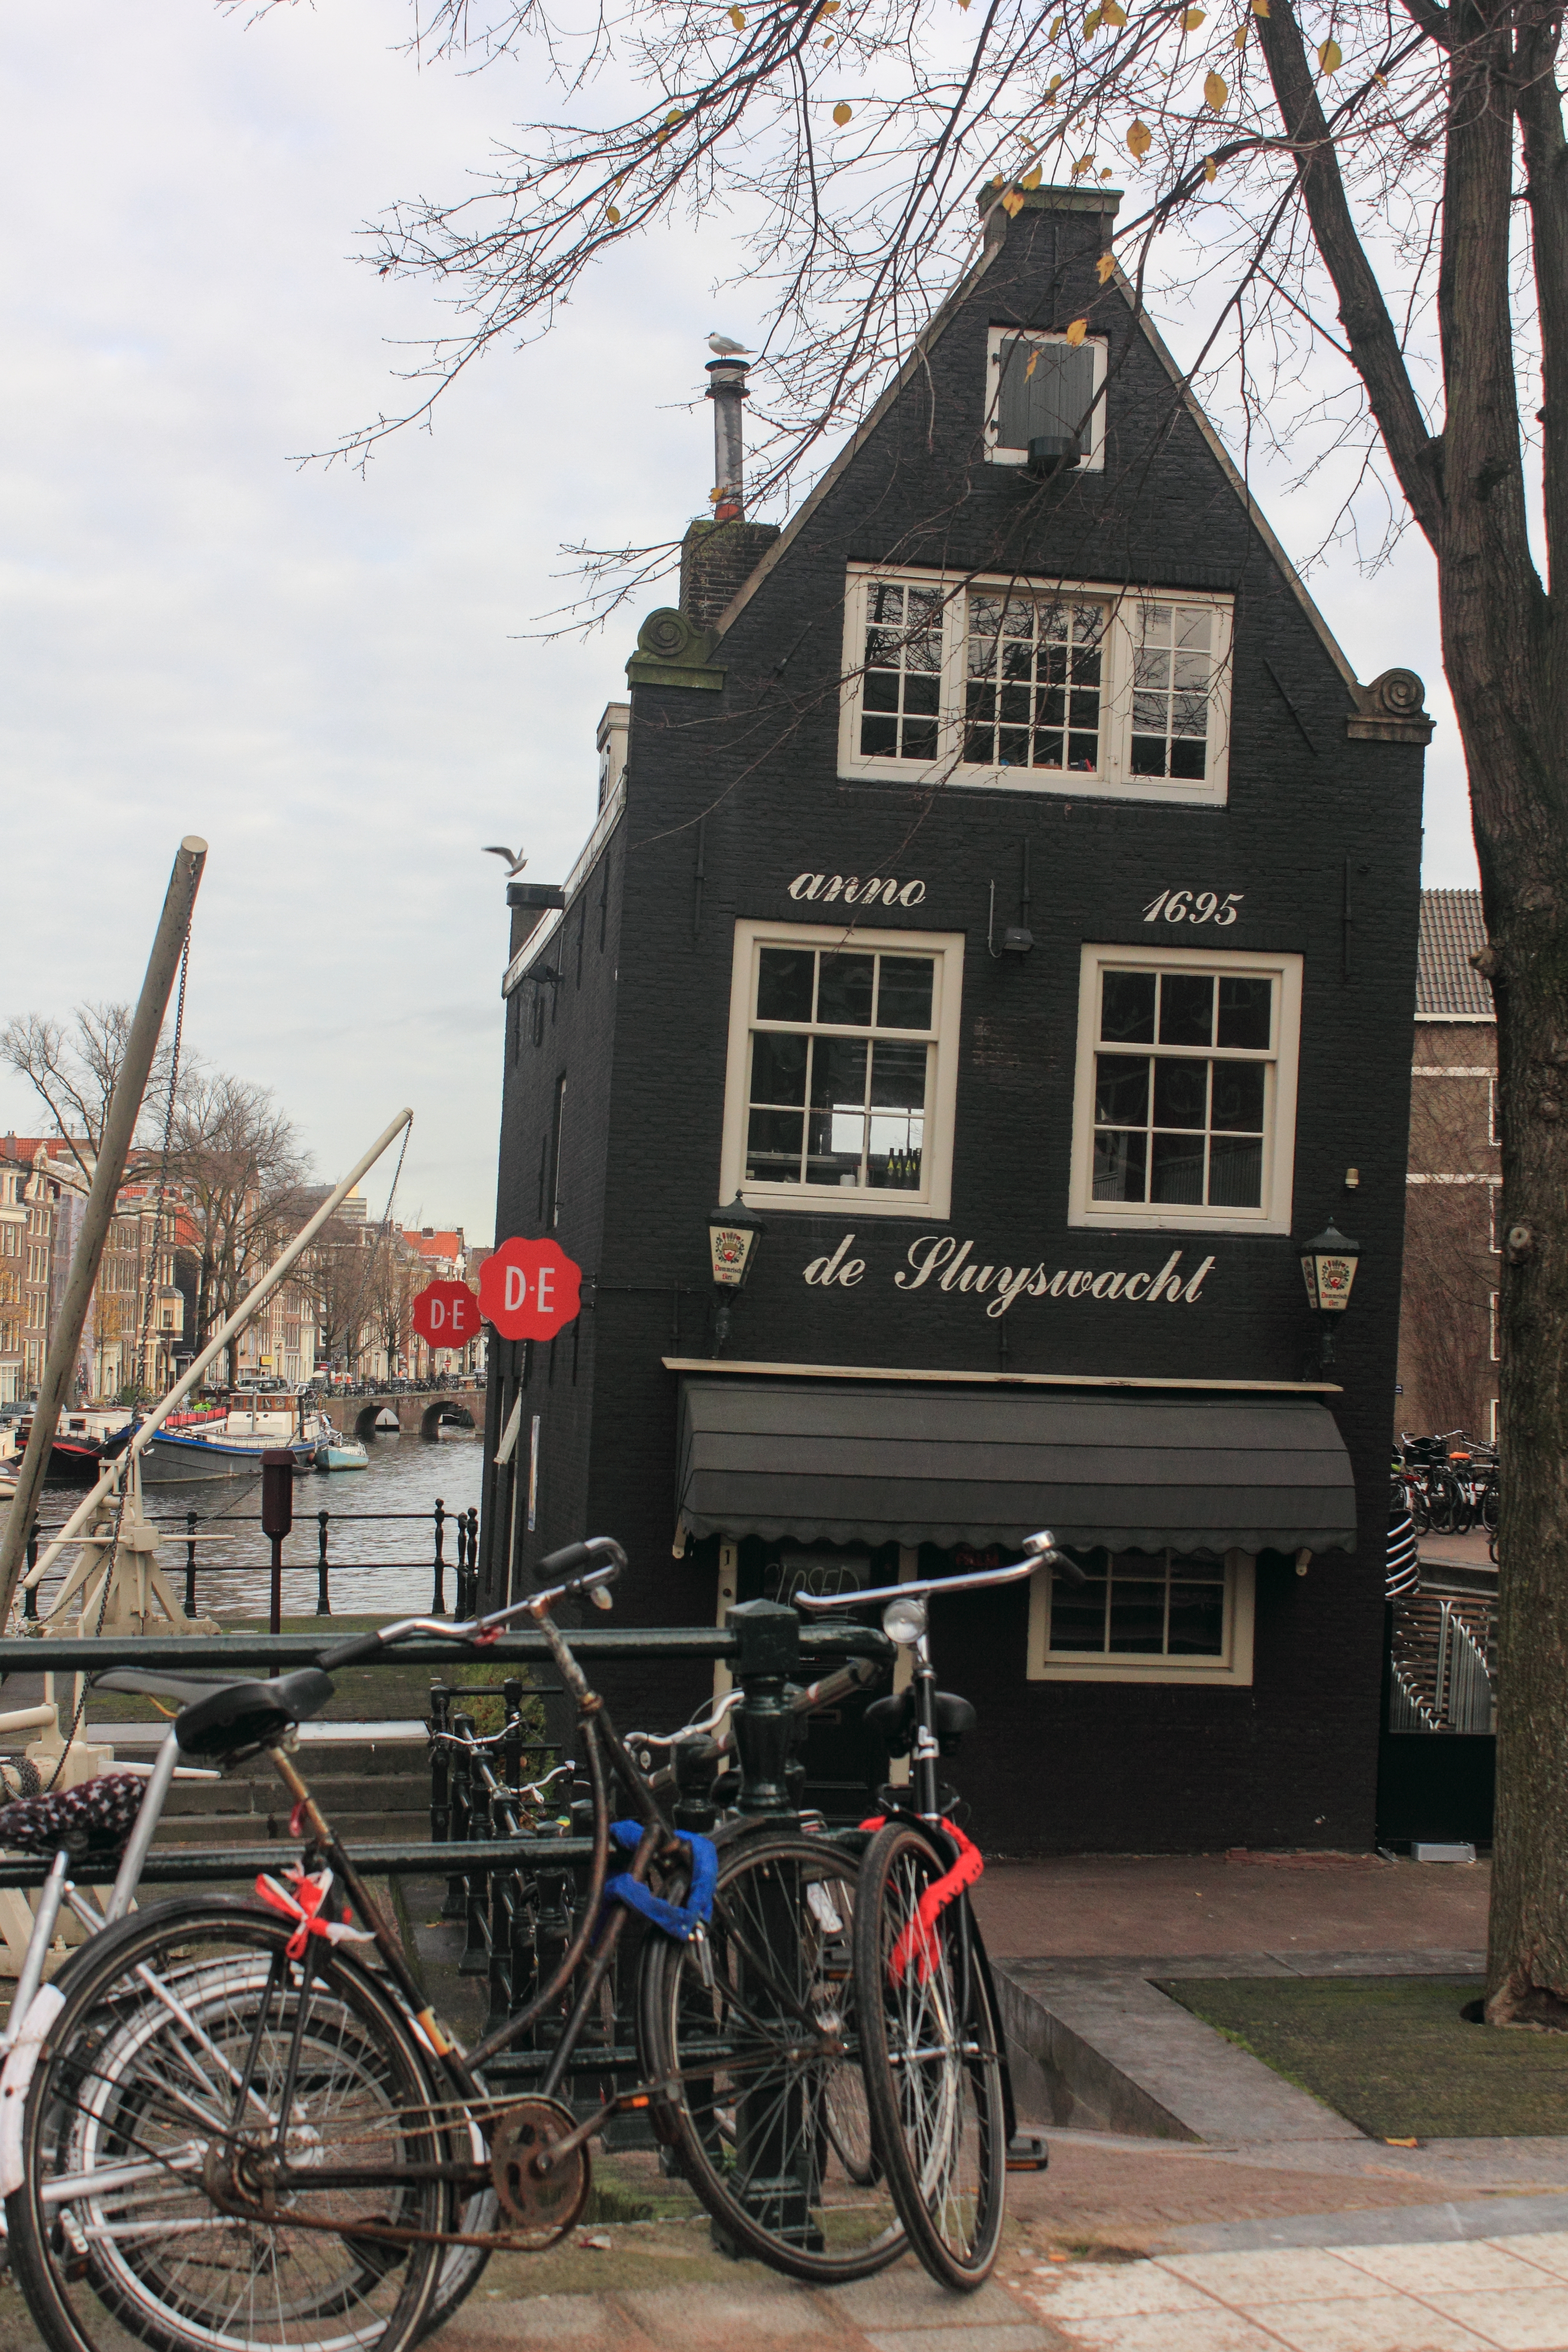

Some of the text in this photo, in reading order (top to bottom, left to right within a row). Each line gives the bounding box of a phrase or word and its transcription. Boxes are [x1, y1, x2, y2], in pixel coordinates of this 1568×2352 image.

[788, 873, 926, 907] anno
[1142, 889, 1244, 925] 1695
[803, 1235, 1215, 1317] de Sluyswacht
